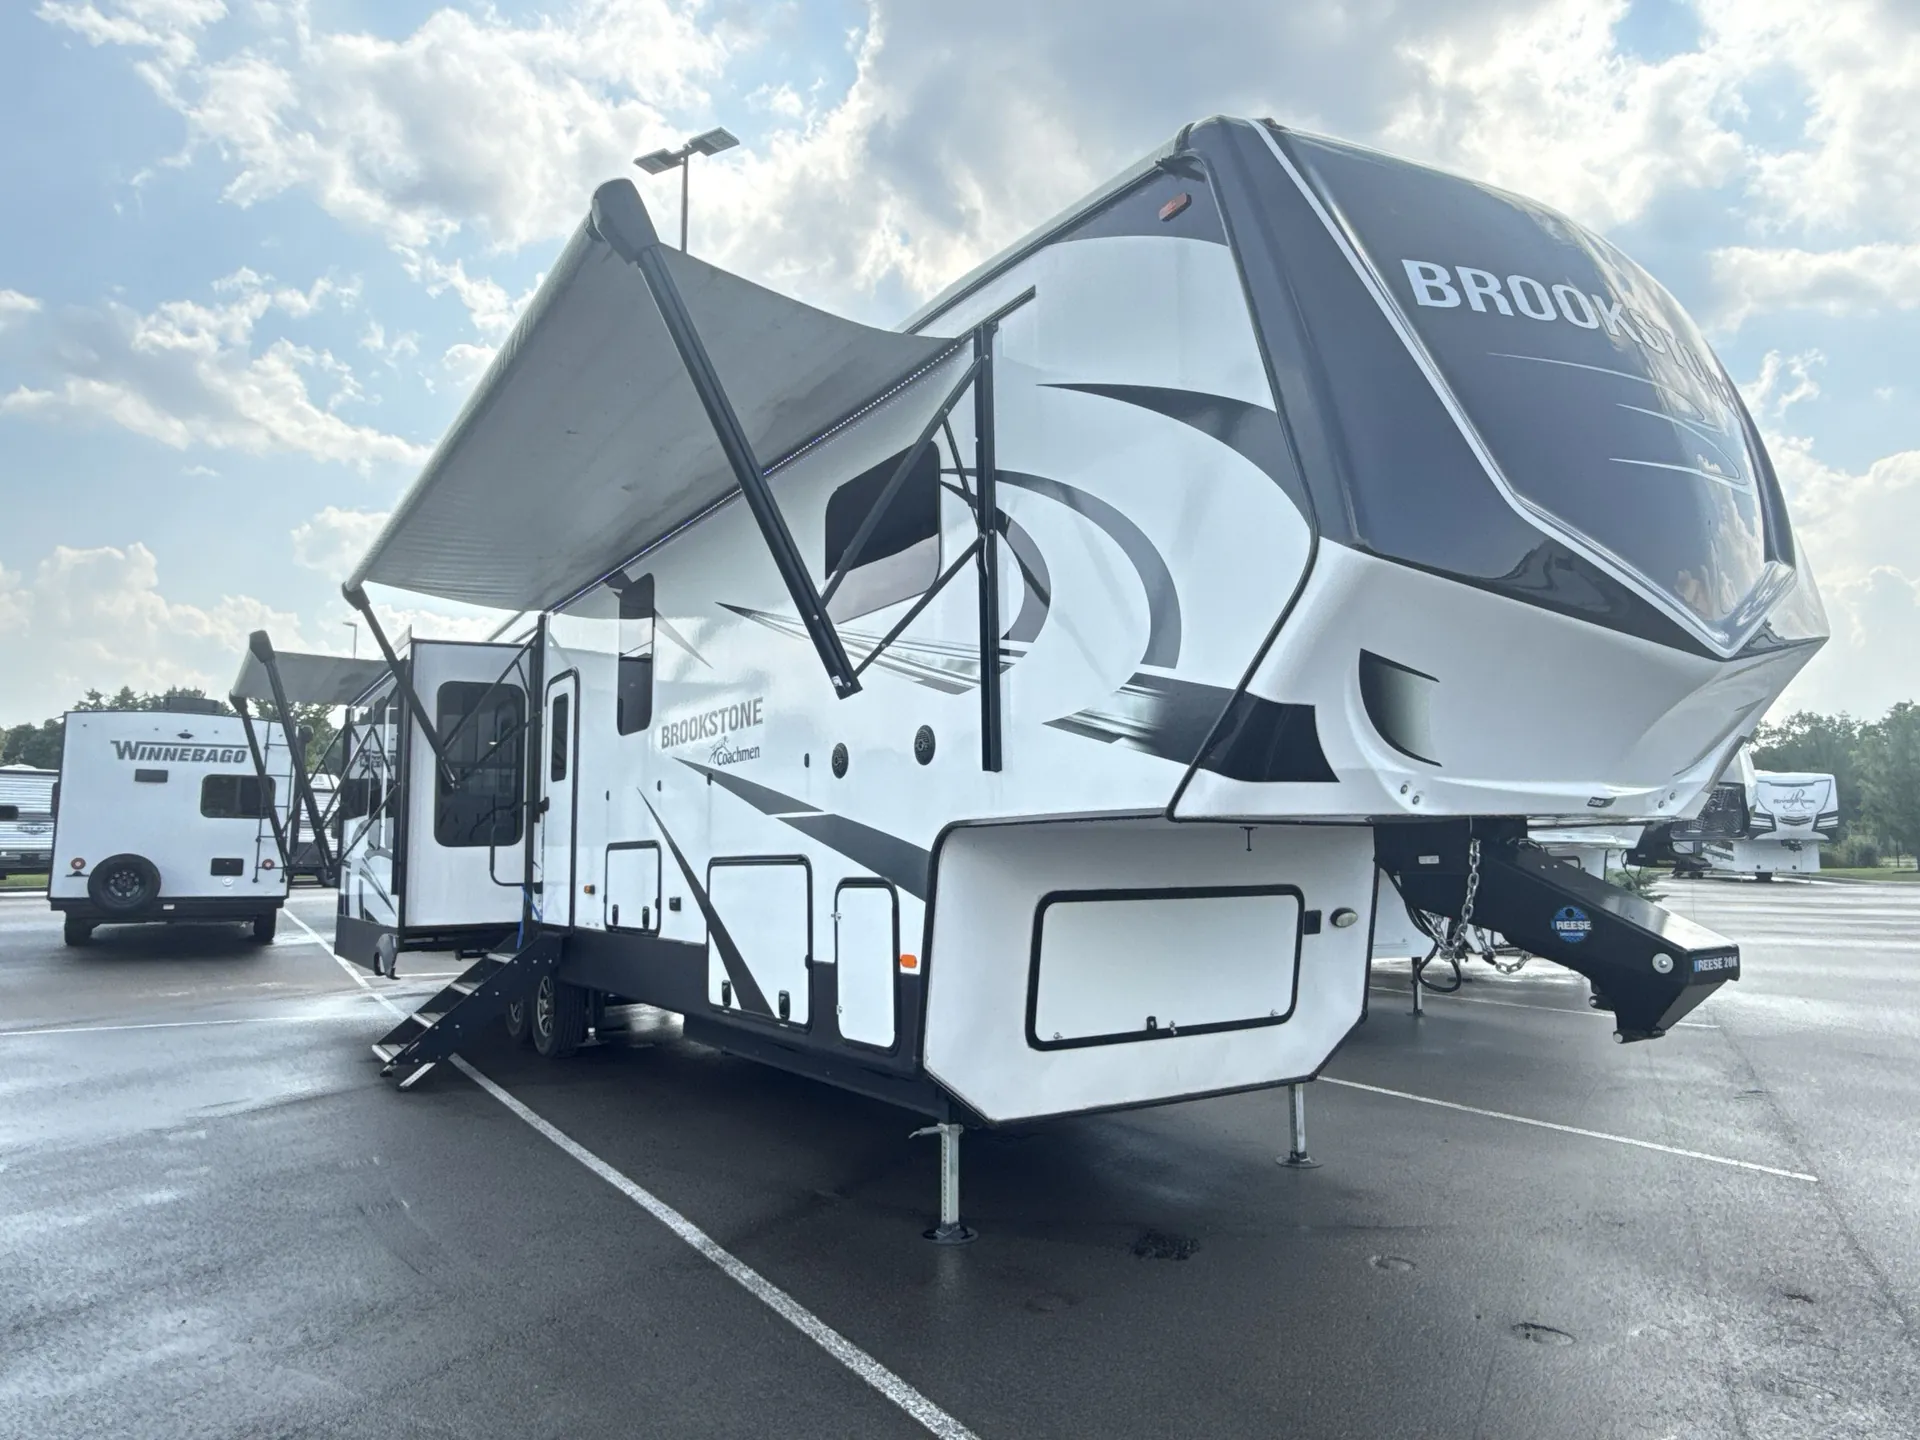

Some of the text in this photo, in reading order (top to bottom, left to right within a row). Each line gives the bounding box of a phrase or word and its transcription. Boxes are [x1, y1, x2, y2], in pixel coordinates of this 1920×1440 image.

[661, 697, 764, 749] BROOKSTONE
[110, 740, 249, 763] WINNEBAGO
[717, 745, 761, 766] Coachmen
[1556, 920, 1592, 931] REESE
[1698, 957, 1723, 971] REESE
